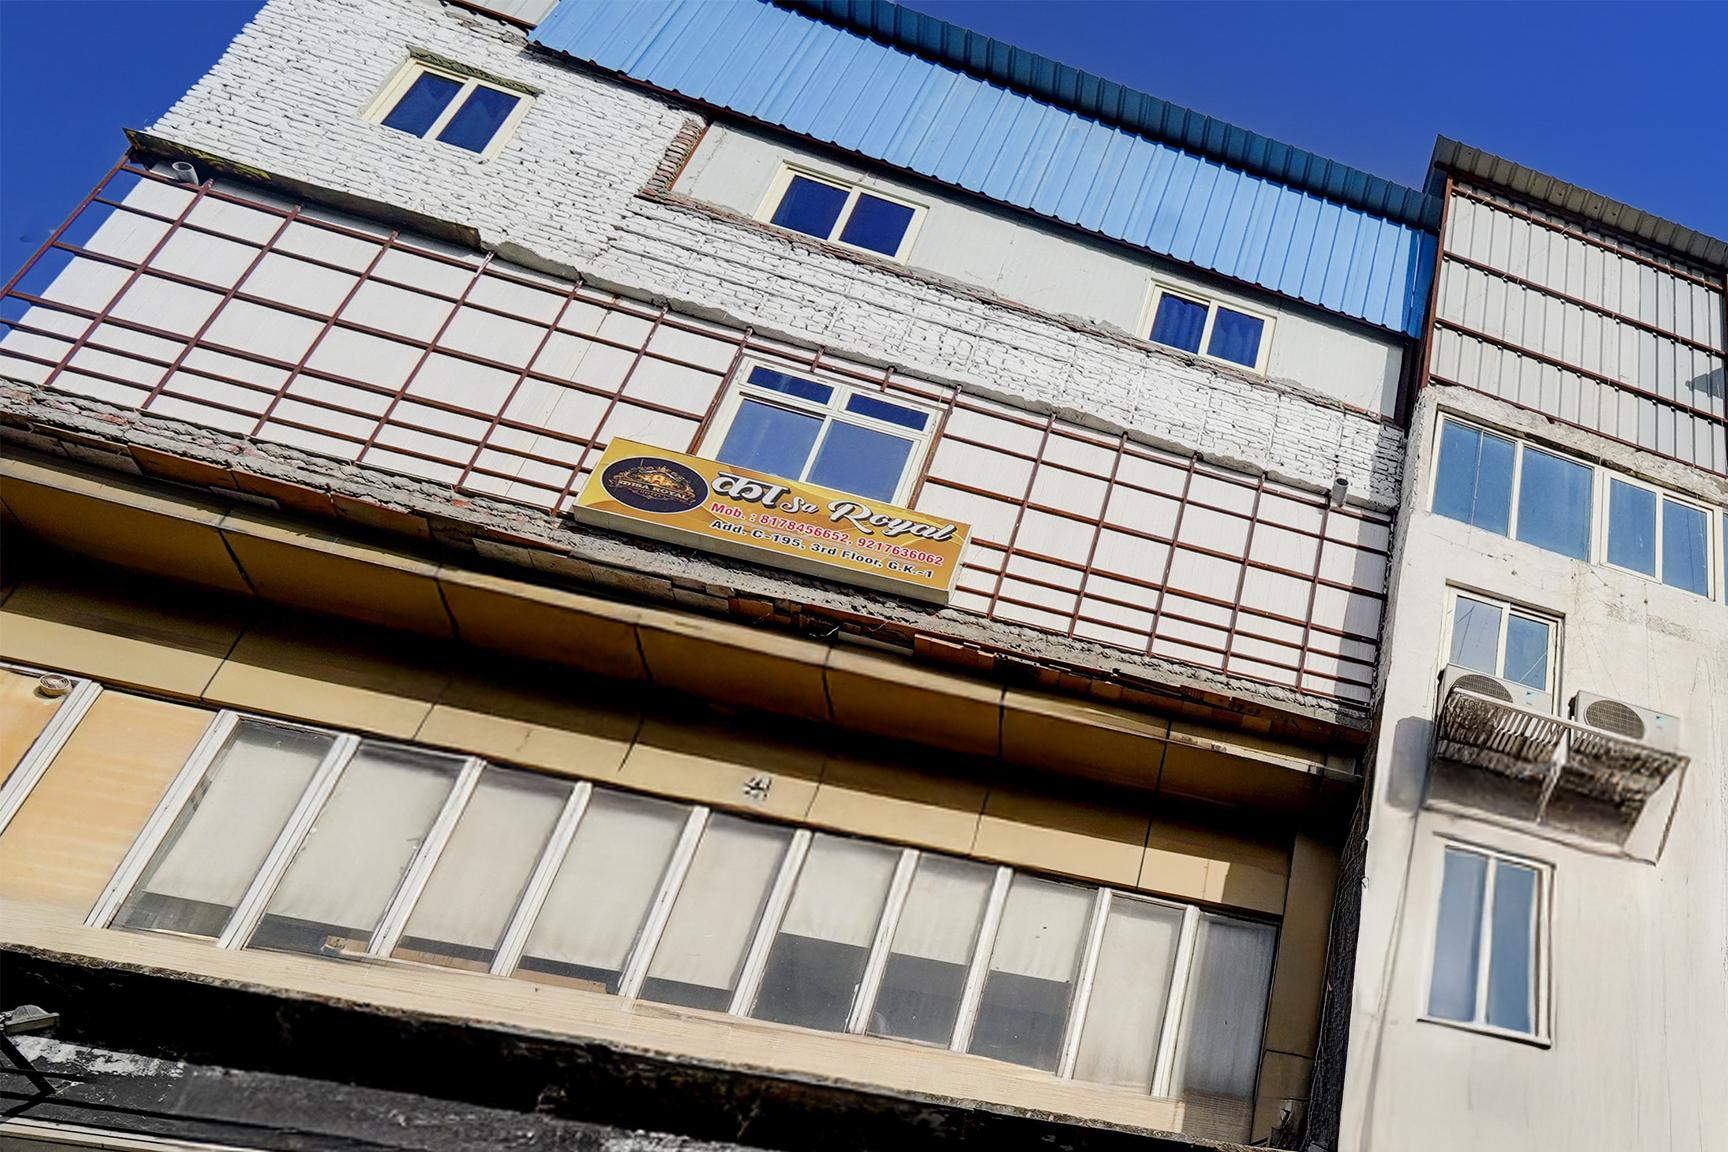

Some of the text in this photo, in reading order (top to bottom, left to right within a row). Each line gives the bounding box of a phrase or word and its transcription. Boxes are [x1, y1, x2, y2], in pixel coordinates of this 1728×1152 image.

[711, 471, 957, 543] का Sa Royal
[711, 503, 745, 519] Mob.
[857, 537, 944, 566] 9217636062
[712, 521, 746, 535] Add.
[811, 543, 837, 556] 3rd
